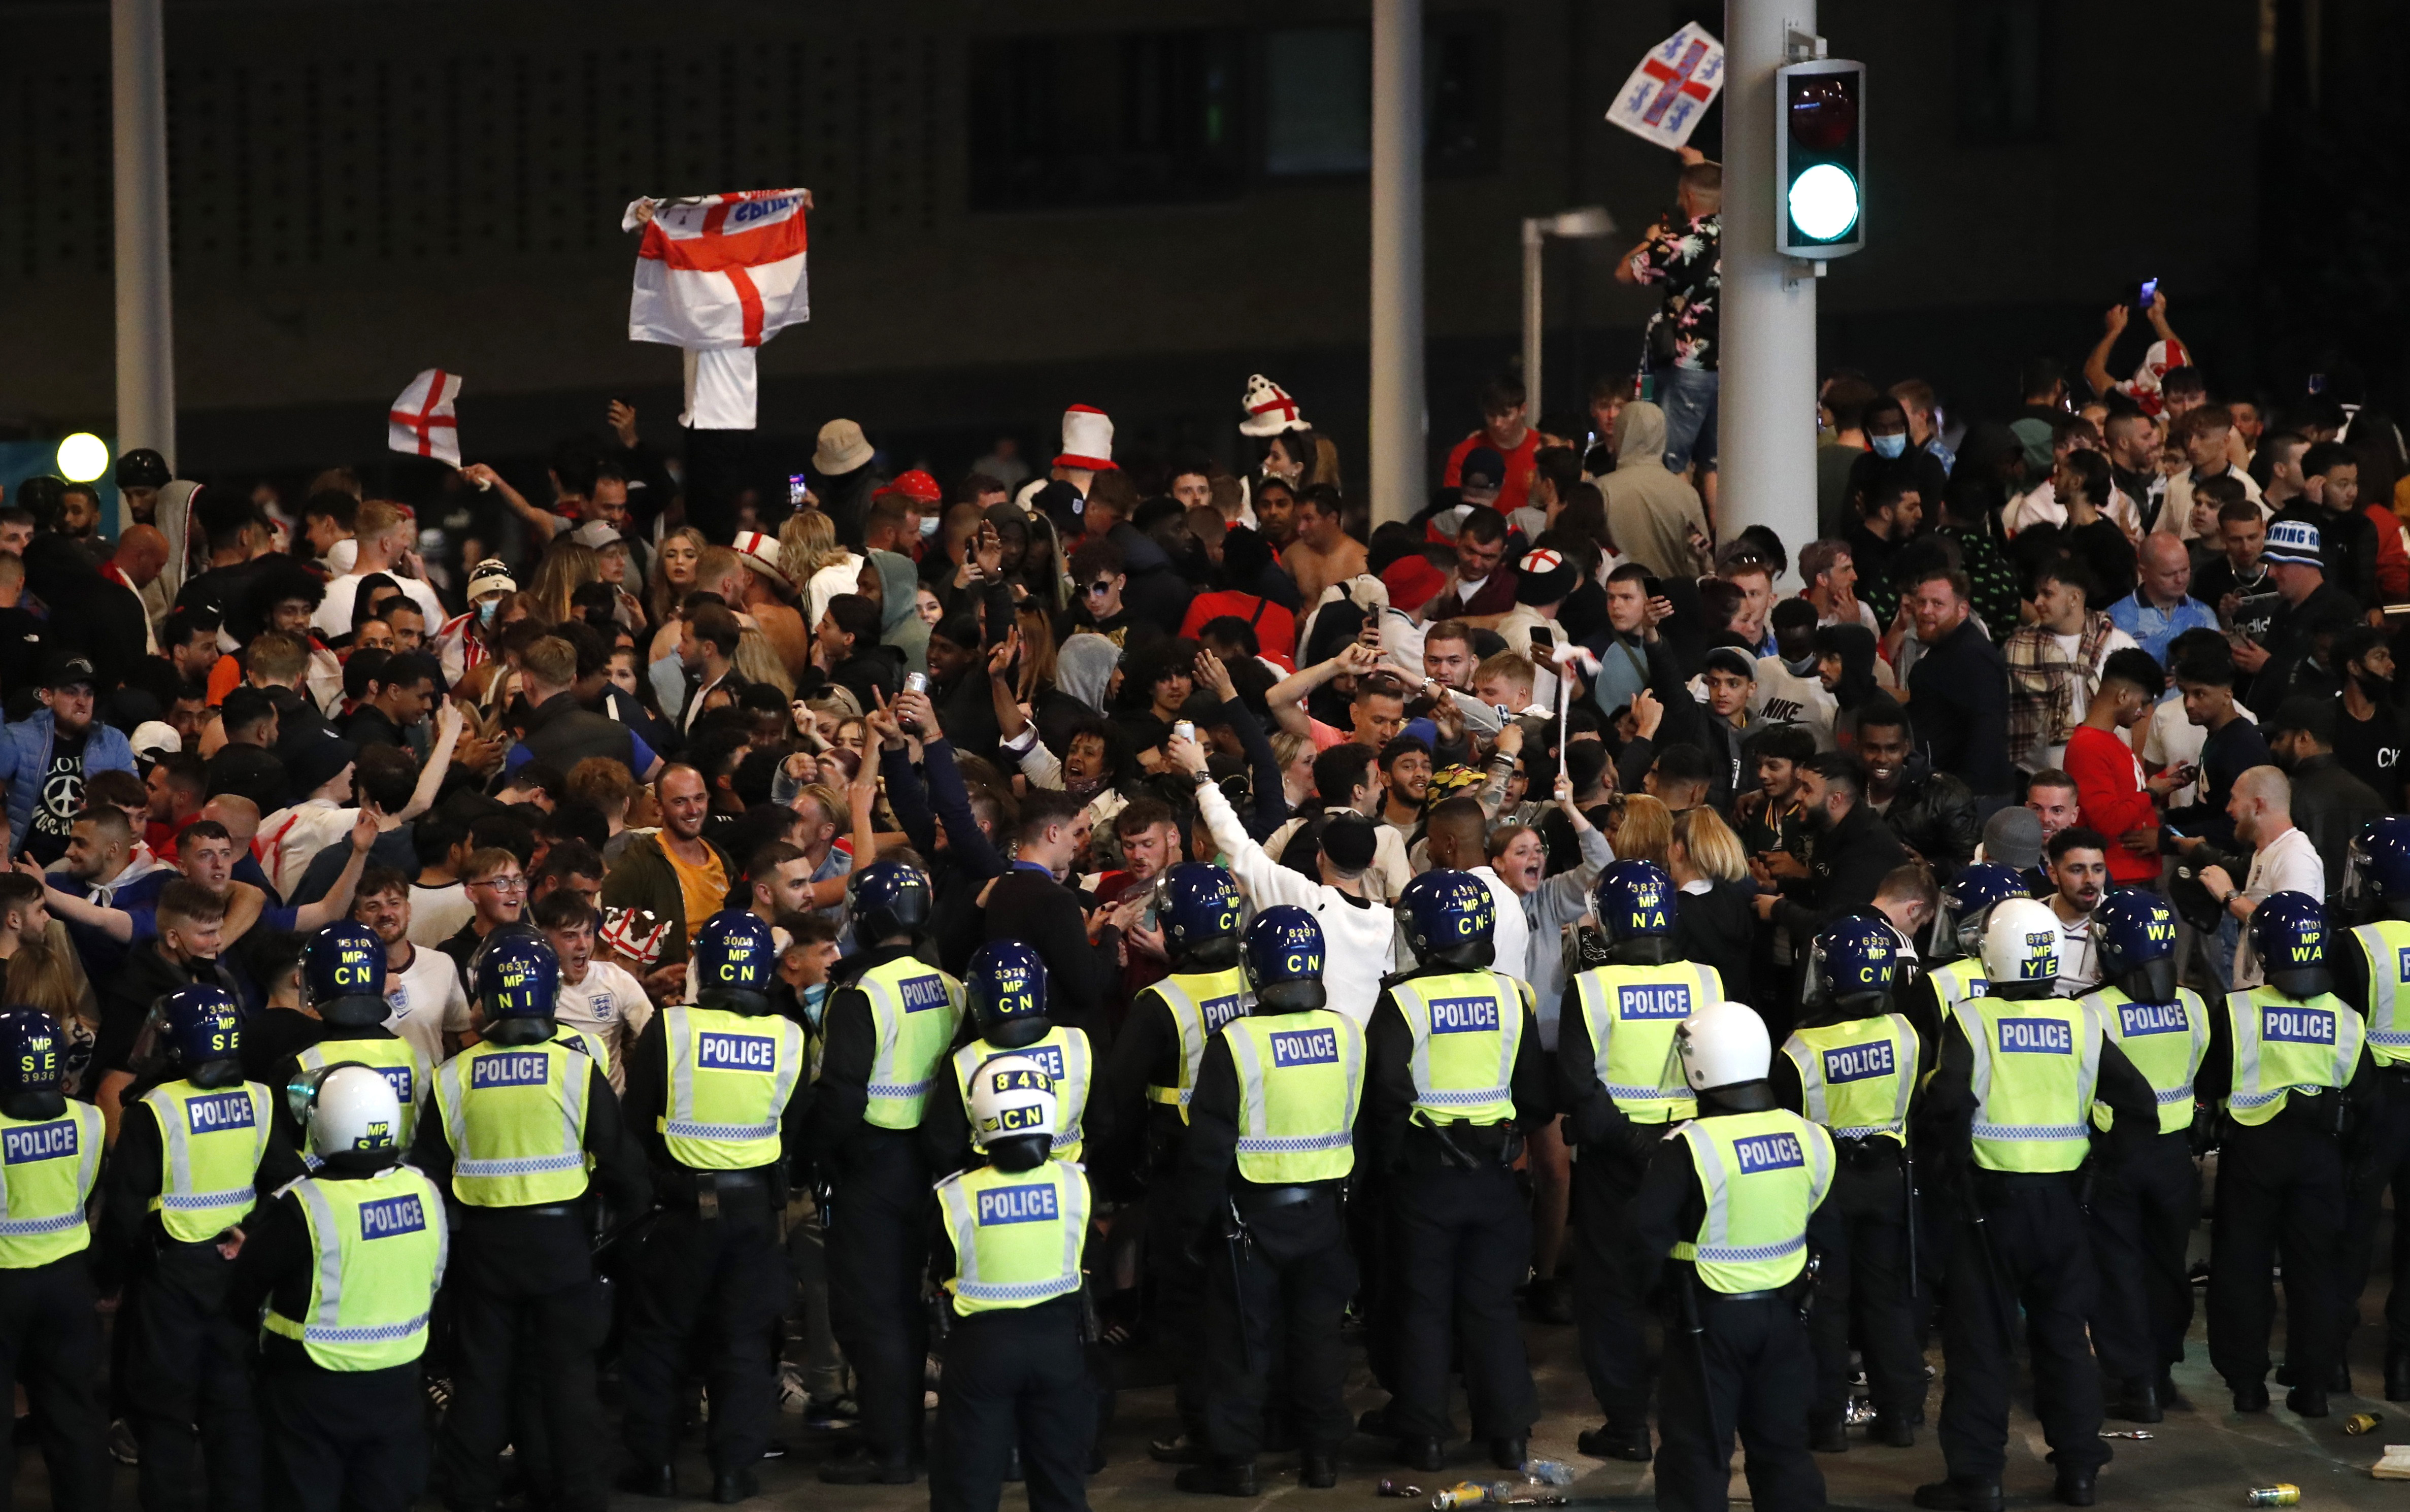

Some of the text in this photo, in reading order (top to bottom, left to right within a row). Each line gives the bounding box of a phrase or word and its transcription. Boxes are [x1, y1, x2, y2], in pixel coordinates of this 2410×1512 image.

[1761, 697, 1804, 721] NIKE
[1631, 882, 1663, 893] 3827
[1227, 896, 1240, 908] MP
[1462, 898, 1478, 912] MP
[1638, 895, 1659, 908] MP
[1632, 911, 1666, 928] NA
[2153, 909, 2170, 921] MP
[1458, 914, 1483, 934] CN
[2147, 924, 2176, 941] WA
[1289, 928, 1316, 938] 8297
[2027, 932, 2055, 944] 8788
[2301, 932, 2320, 944] MP
[342, 951, 363, 963] MP
[728, 949, 750, 961] MP
[1868, 948, 1887, 960] MP
[2033, 945, 2052, 957] MP
[2291, 946, 2323, 962] WA
[498, 960, 529, 973] 0637
[1287, 955, 1319, 972] CN
[2025, 959, 2057, 977] YE
[334, 966, 371, 985] CN
[503, 975, 525, 987] MP
[720, 964, 755, 981] CN
[1860, 966, 1891, 983] CN
[902, 979, 947, 1007] POLICE
[1002, 980, 1023, 993] MP
[998, 993, 1033, 1013] CN
[1623, 990, 1688, 1014] POLICE
[219, 1017, 236, 1030] MP
[1433, 1002, 1496, 1028] POLICE
[2122, 1005, 2186, 1031] POLICE
[2266, 1013, 2332, 1039] POLICE
[32, 1038, 52, 1051] MP
[212, 1032, 240, 1051] SE
[2002, 1024, 2069, 1048] POLICE
[702, 1038, 772, 1066] POLICE
[1275, 1034, 1335, 1061] POLICE
[21, 1053, 56, 1071] SE
[475, 1057, 545, 1083] POLICE
[1827, 1046, 1892, 1078] POLICE
[22, 1071, 55, 1083] 3936
[190, 1097, 252, 1127] POLICE
[1003, 1106, 1041, 1129] CN
[367, 1123, 388, 1136] MP
[7, 1126, 74, 1158] POLICE
[1738, 1137, 1802, 1167] POLICE
[980, 1189, 1055, 1219] POLICE
[363, 1200, 423, 1233] POLICE
